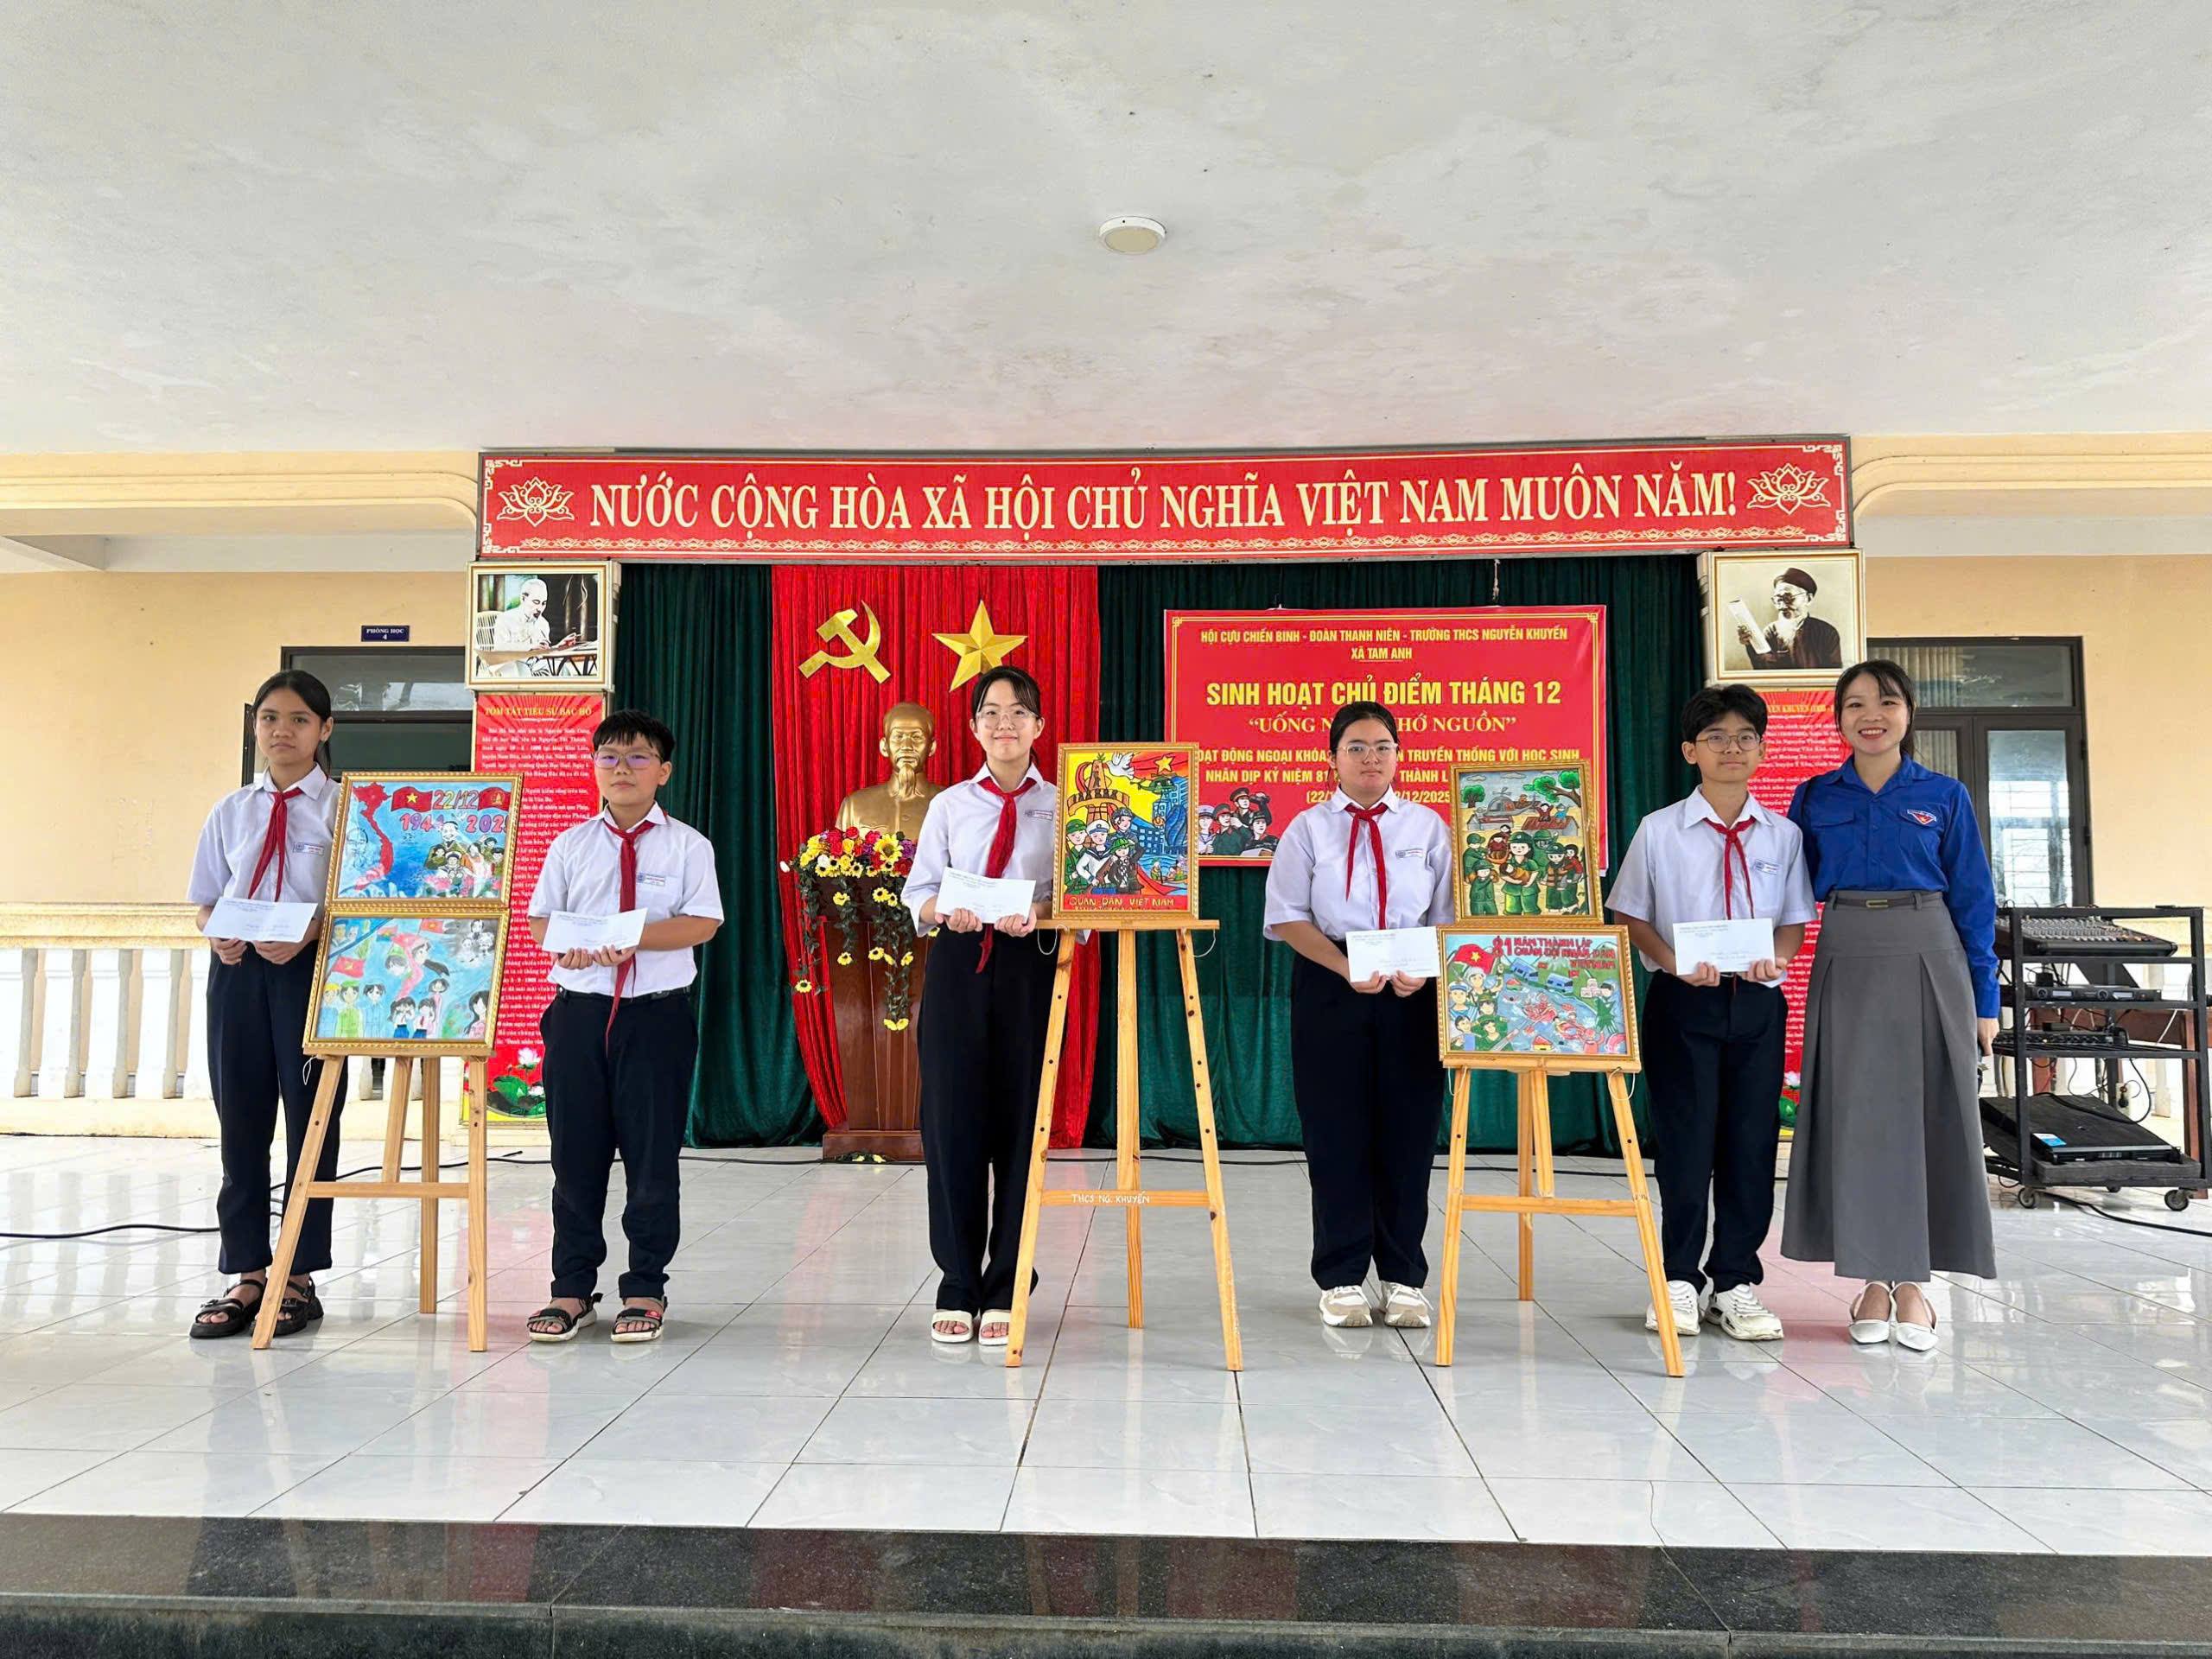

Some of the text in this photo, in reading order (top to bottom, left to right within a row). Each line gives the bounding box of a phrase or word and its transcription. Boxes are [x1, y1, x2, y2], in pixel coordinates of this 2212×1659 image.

[589, 461, 1737, 541] NƯỚC CỘNG HÒA XÃ HỘI CHỦ NGHĨA VIỆT NAM MUÔN NĂM!
[1201, 629, 1217, 645] HỘI
[1220, 630, 1241, 645] CỰU
[1243, 627, 1273, 642] CHIẾN
[1275, 631, 1300, 642] BINH
[1309, 628, 1338, 642] ĐOÀN
[1340, 630, 1373, 641] THANH
[1376, 627, 1400, 641] NIÊN
[1410, 626, 1450, 641] TRƯỜNG
[1453, 628, 1479, 640] THCS
[1482, 625, 1523, 640] NGUYỄN
[1526, 625, 1567, 640] KHUYẾN
[1351, 646, 1412, 659] XÃ TAM ANH
[1206, 672, 1561, 709] SINH HOẠT CHỦ ĐIỂM THÁNG 12
[1249, 710, 1315, 733] “UỐNG
[1397, 709, 1517, 732] HỚ NGUỒN”
[1198, 747, 1327, 766] OẠT ĐỘNG NGOẠI KHÓA
[1456, 745, 1496, 762] THỐNG
[1499, 747, 1519, 762] VỚI
[1549, 749, 1580, 761] SINH
[1205, 767, 1237, 783] NHÂN
[1242, 770, 1261, 785] DỊP
[1264, 766, 1280, 783] KỶ
[1282, 768, 1313, 785] NIỆM
[1316, 770, 1329, 783] 81
[1400, 766, 1439, 783] THÀNH
[433, 789, 479, 810] 22/12
[1492, 936, 1512, 958] 81
[1071, 1193, 1094, 1204] THCS
[1116, 1191, 1150, 1204] KHUYẾN
